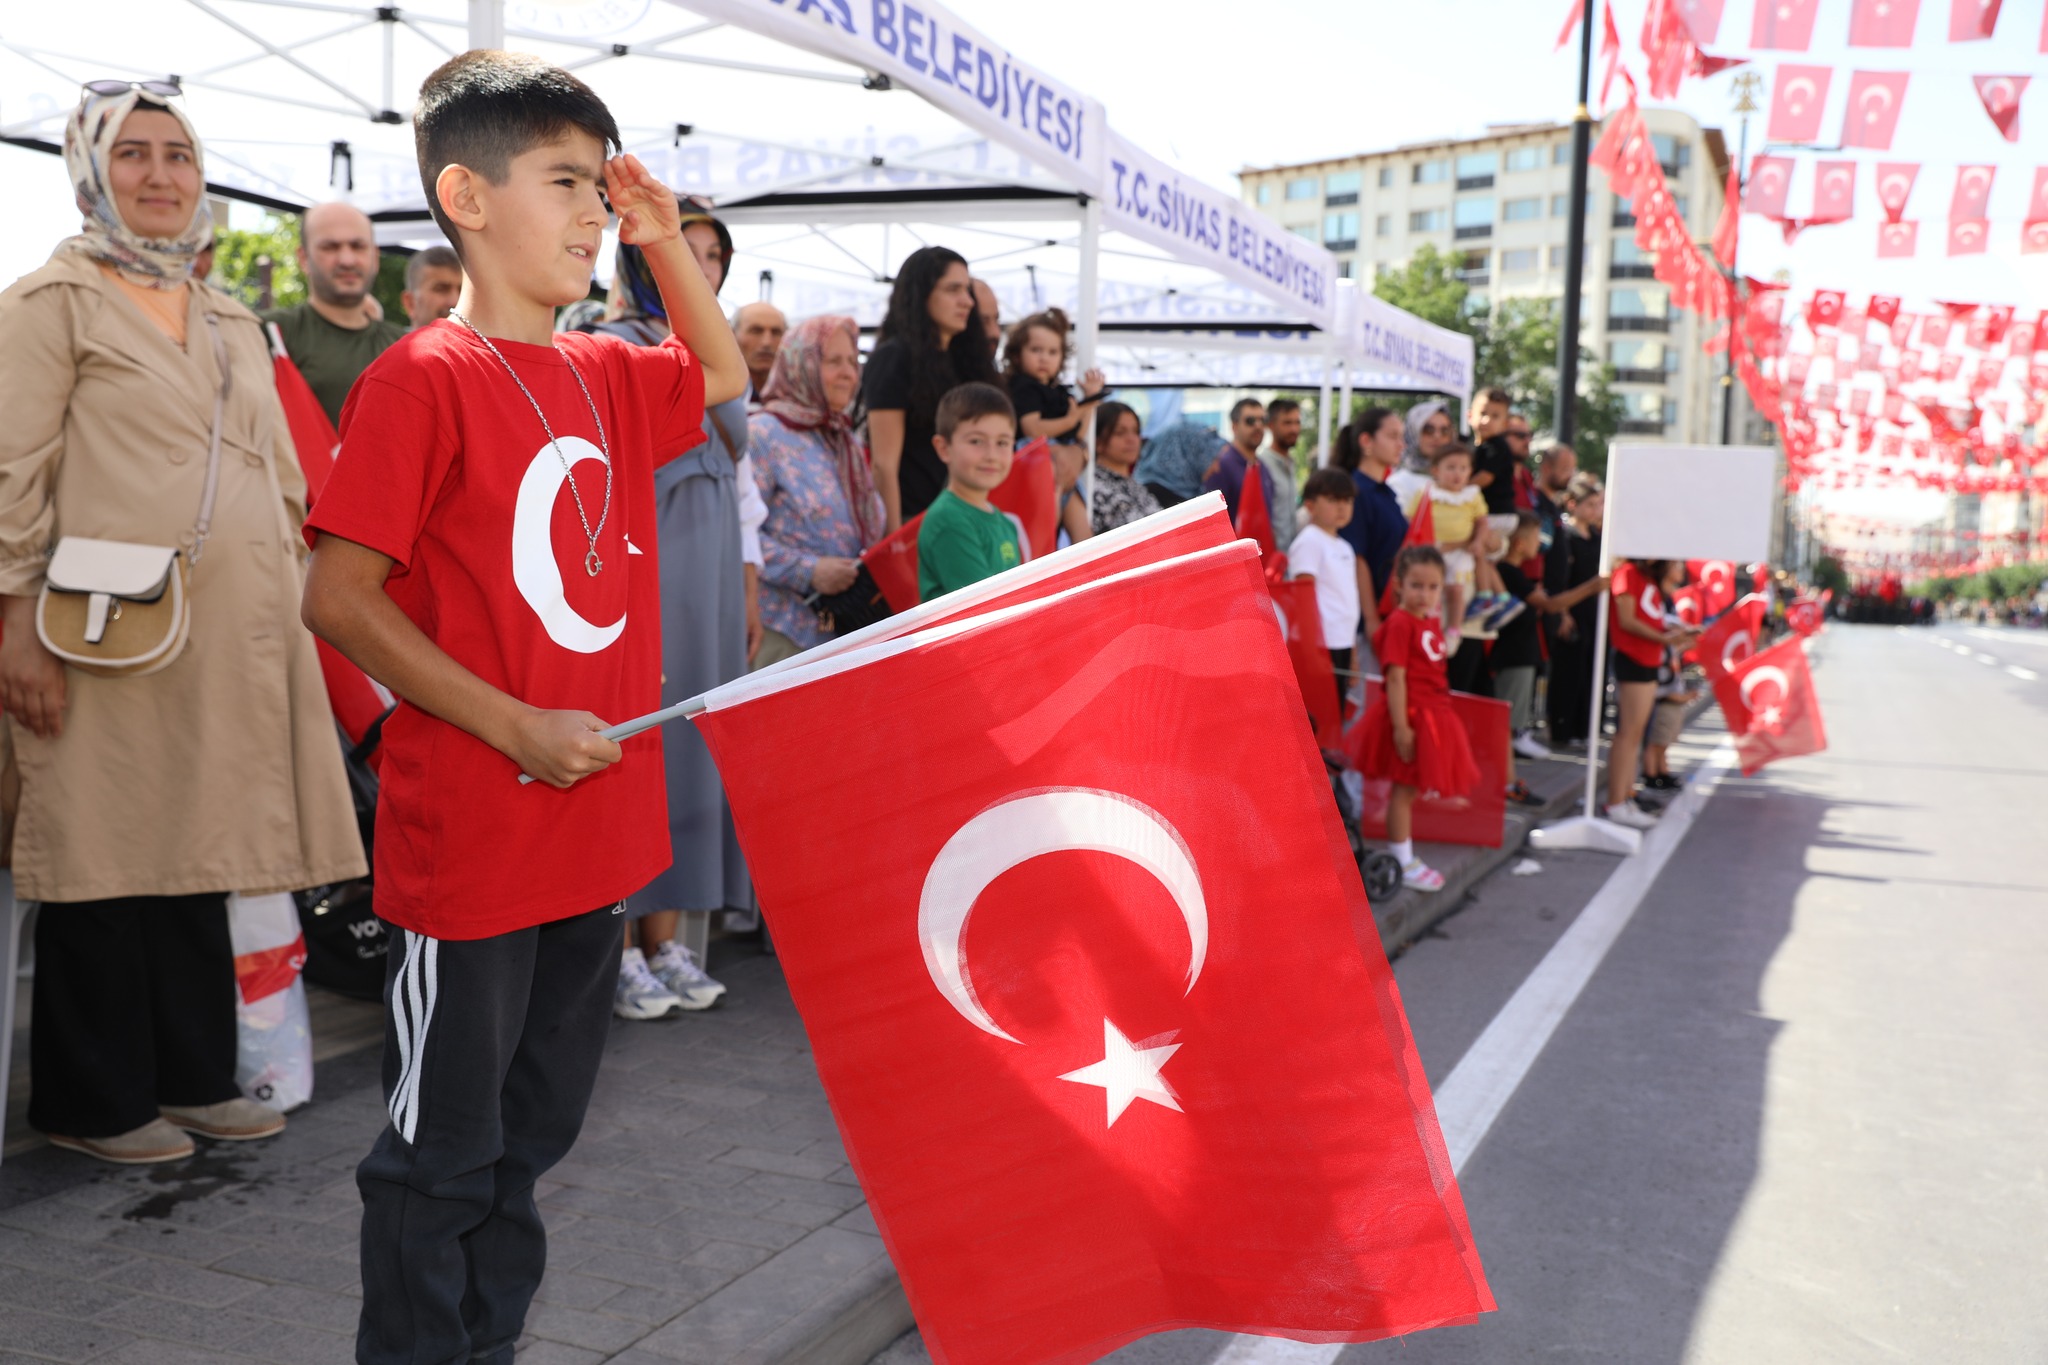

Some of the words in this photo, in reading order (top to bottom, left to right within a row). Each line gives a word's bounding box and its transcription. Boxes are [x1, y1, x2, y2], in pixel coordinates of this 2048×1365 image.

[871, 0, 1083, 161] BELEDİYESİ
[1111, 159, 1221, 252] T.C.SİVAS
[1228, 215, 1327, 308] BELEDİYESİ
